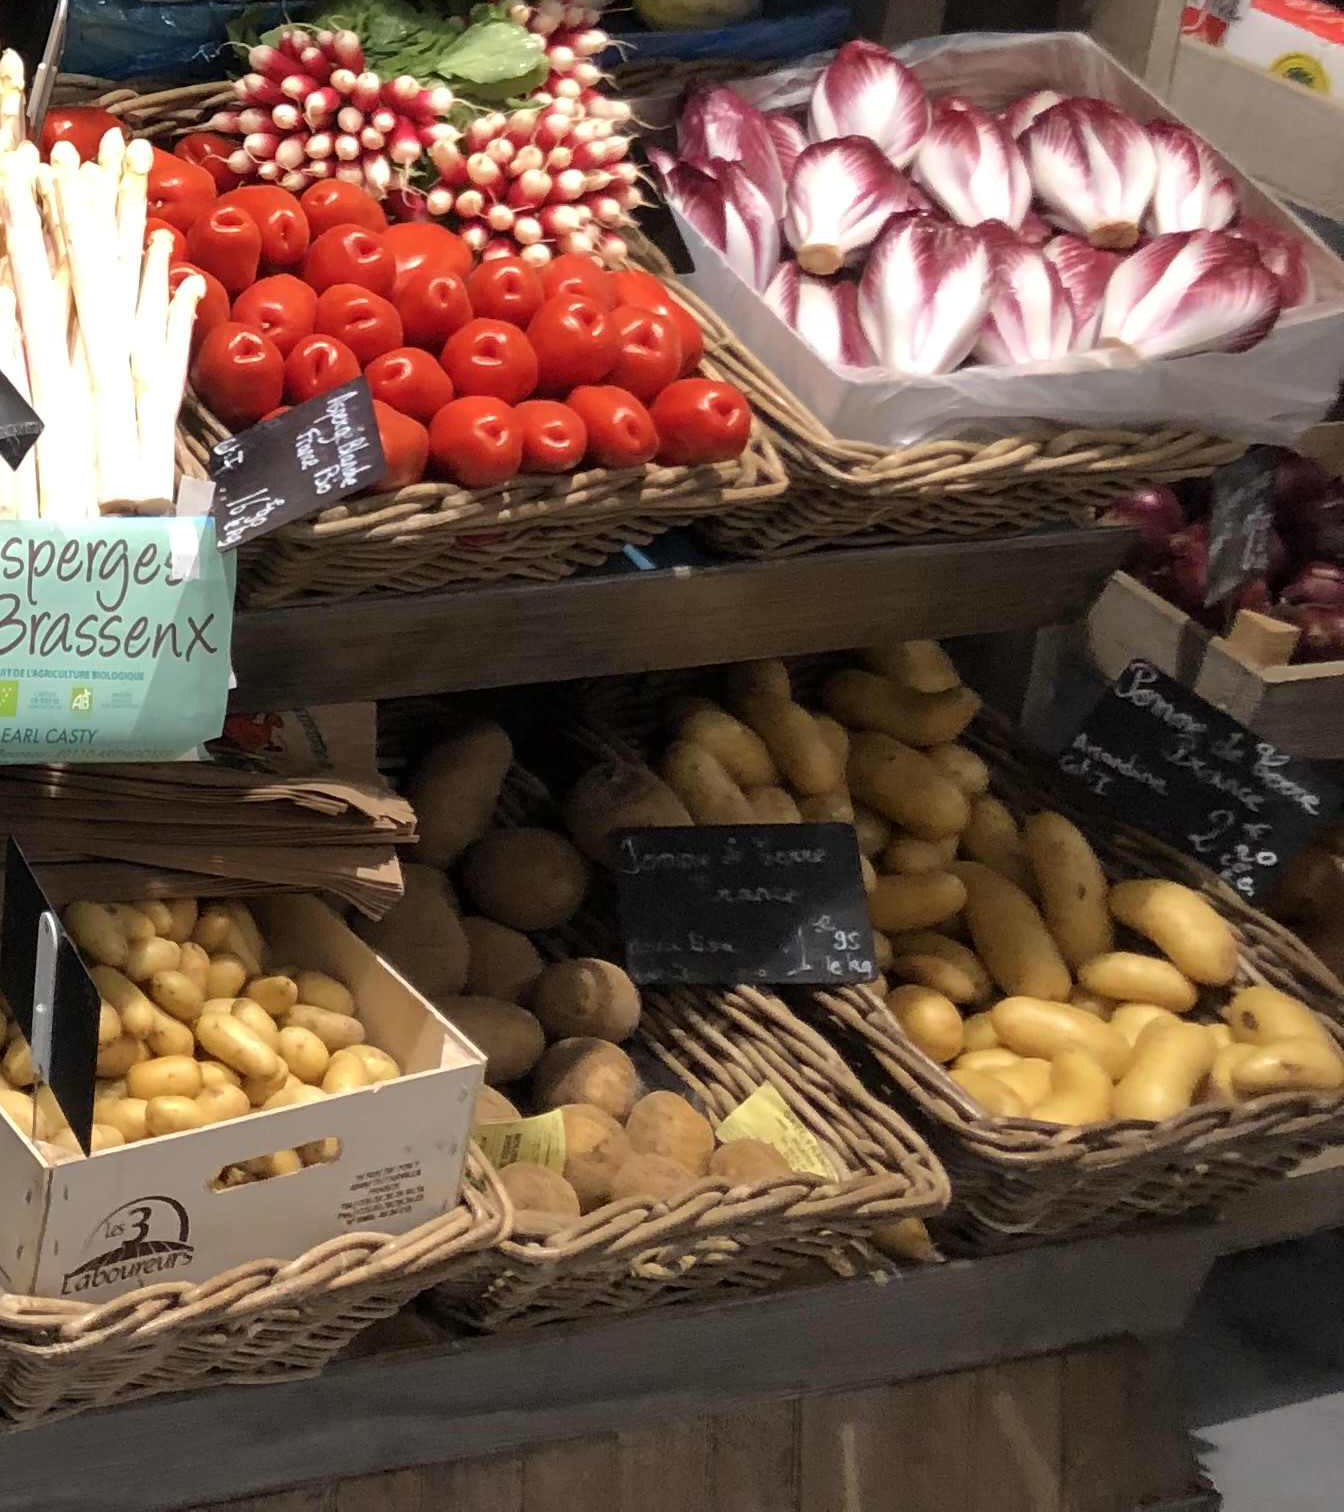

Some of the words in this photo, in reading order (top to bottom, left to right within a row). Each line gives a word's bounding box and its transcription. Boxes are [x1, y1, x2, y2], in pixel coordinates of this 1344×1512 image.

[13, 669, 25, 678] DE
[26, 669, 90, 680] L'AGRICULTURE
[92, 671, 145, 681] BIOLOGIQUE
[1, 727, 40, 743] EARL
[44, 728, 98, 744] CASTY
[121, 1206, 153, 1246] 3
[61, 1251, 194, 1296] Laboureurs
